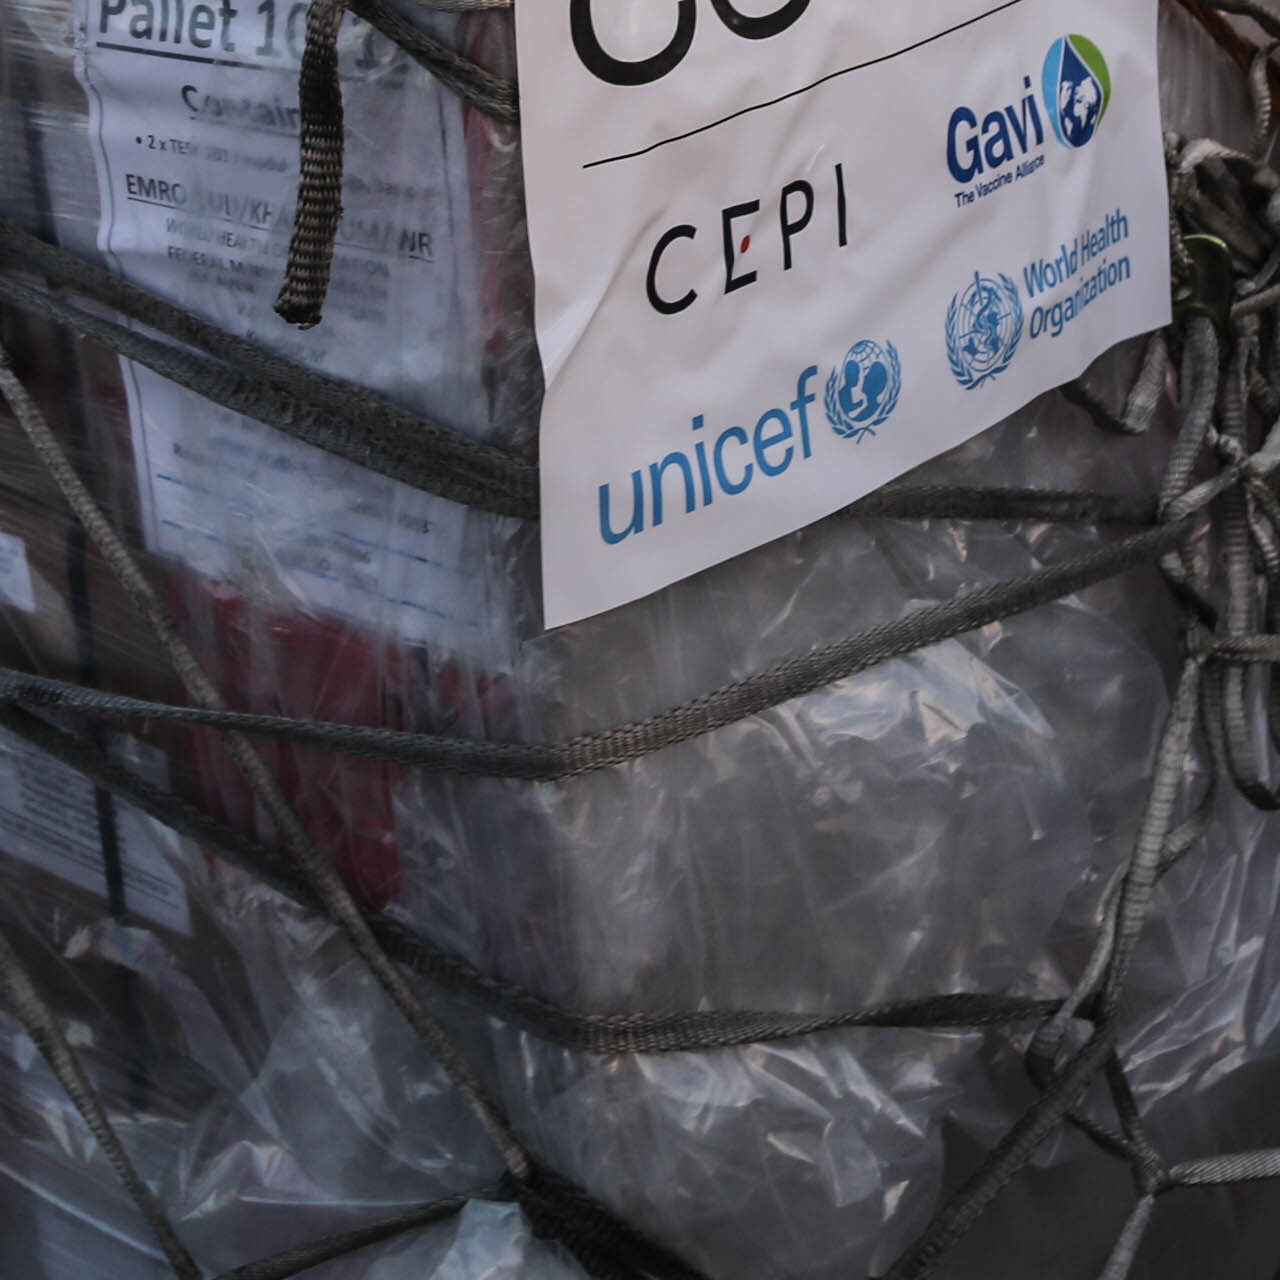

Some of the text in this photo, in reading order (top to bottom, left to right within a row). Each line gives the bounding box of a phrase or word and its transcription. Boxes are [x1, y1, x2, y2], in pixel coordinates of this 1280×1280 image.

[946, 74, 1045, 184] Gavi
[954, 153, 1046, 209] The Vaccine Alliance
[645, 163, 848, 316] CEPI
[1023, 207, 1129, 299] World Health
[1028, 255, 1132, 340] Organization
[598, 364, 818, 546] unicef
